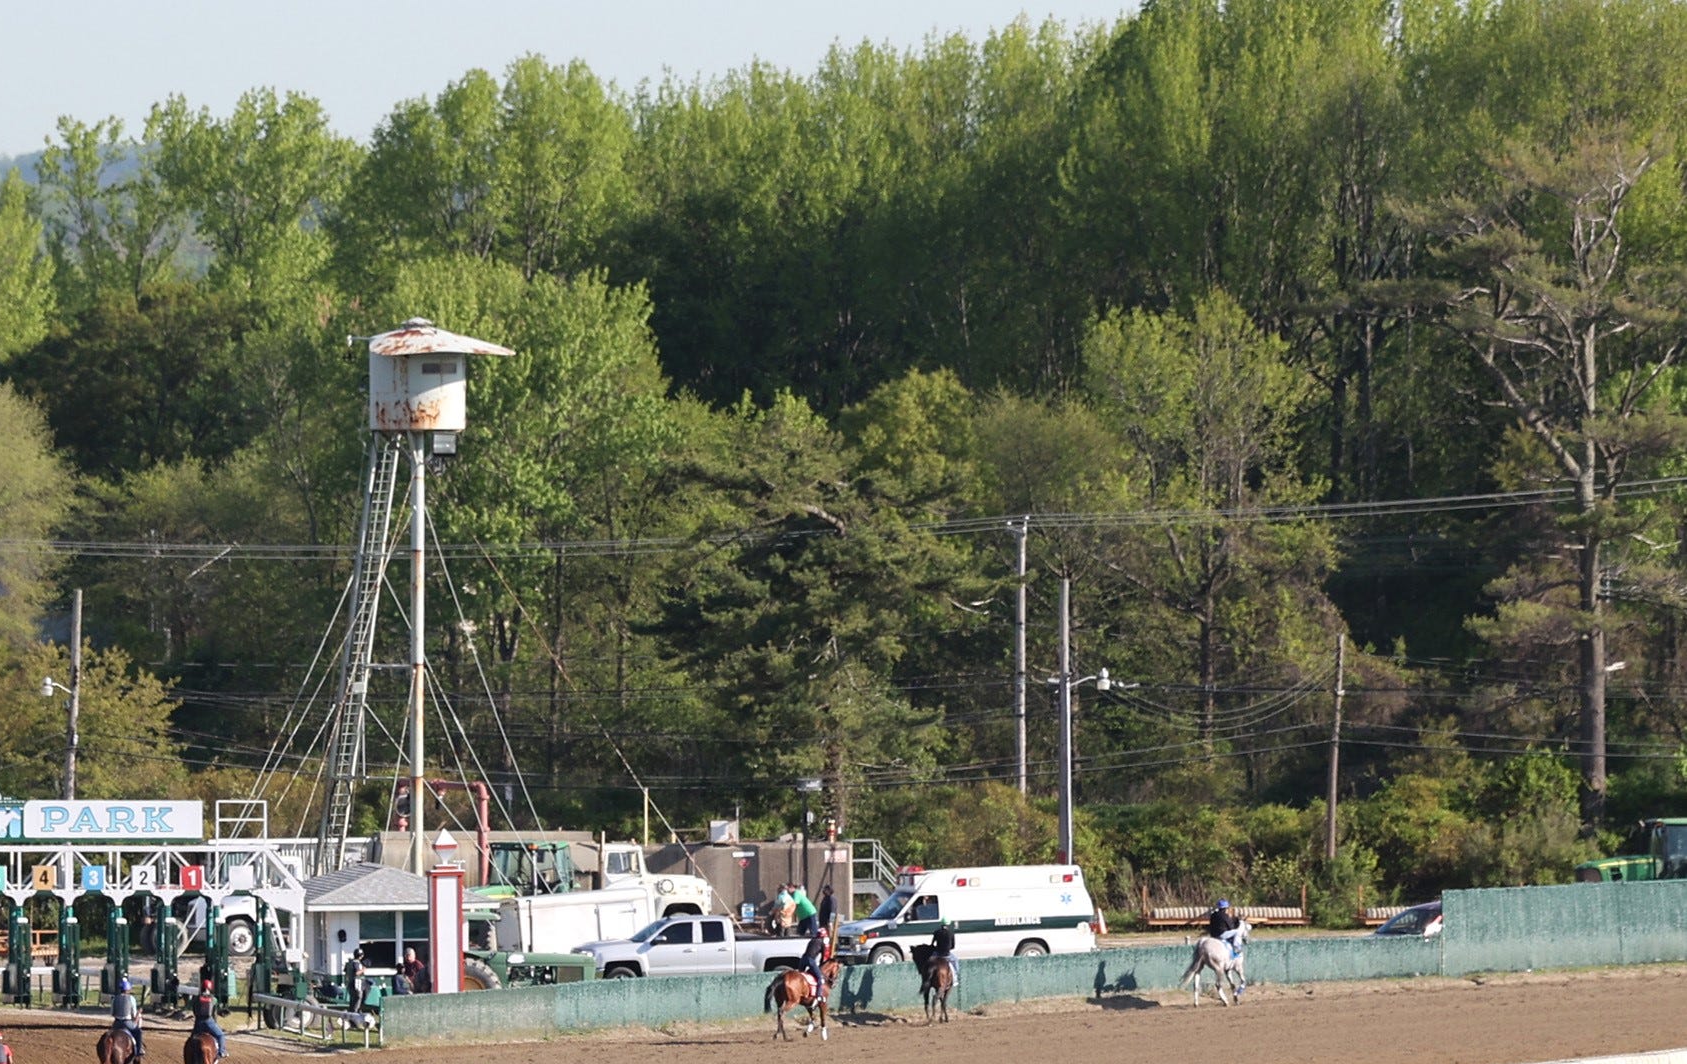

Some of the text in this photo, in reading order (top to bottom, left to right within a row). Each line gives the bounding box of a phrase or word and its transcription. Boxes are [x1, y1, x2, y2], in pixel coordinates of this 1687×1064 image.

[41, 806, 173, 833] PARK
[39, 870, 49, 885] 4
[89, 870, 99, 885] 3
[139, 871, 148, 885] 2
[188, 870, 196, 886] 1
